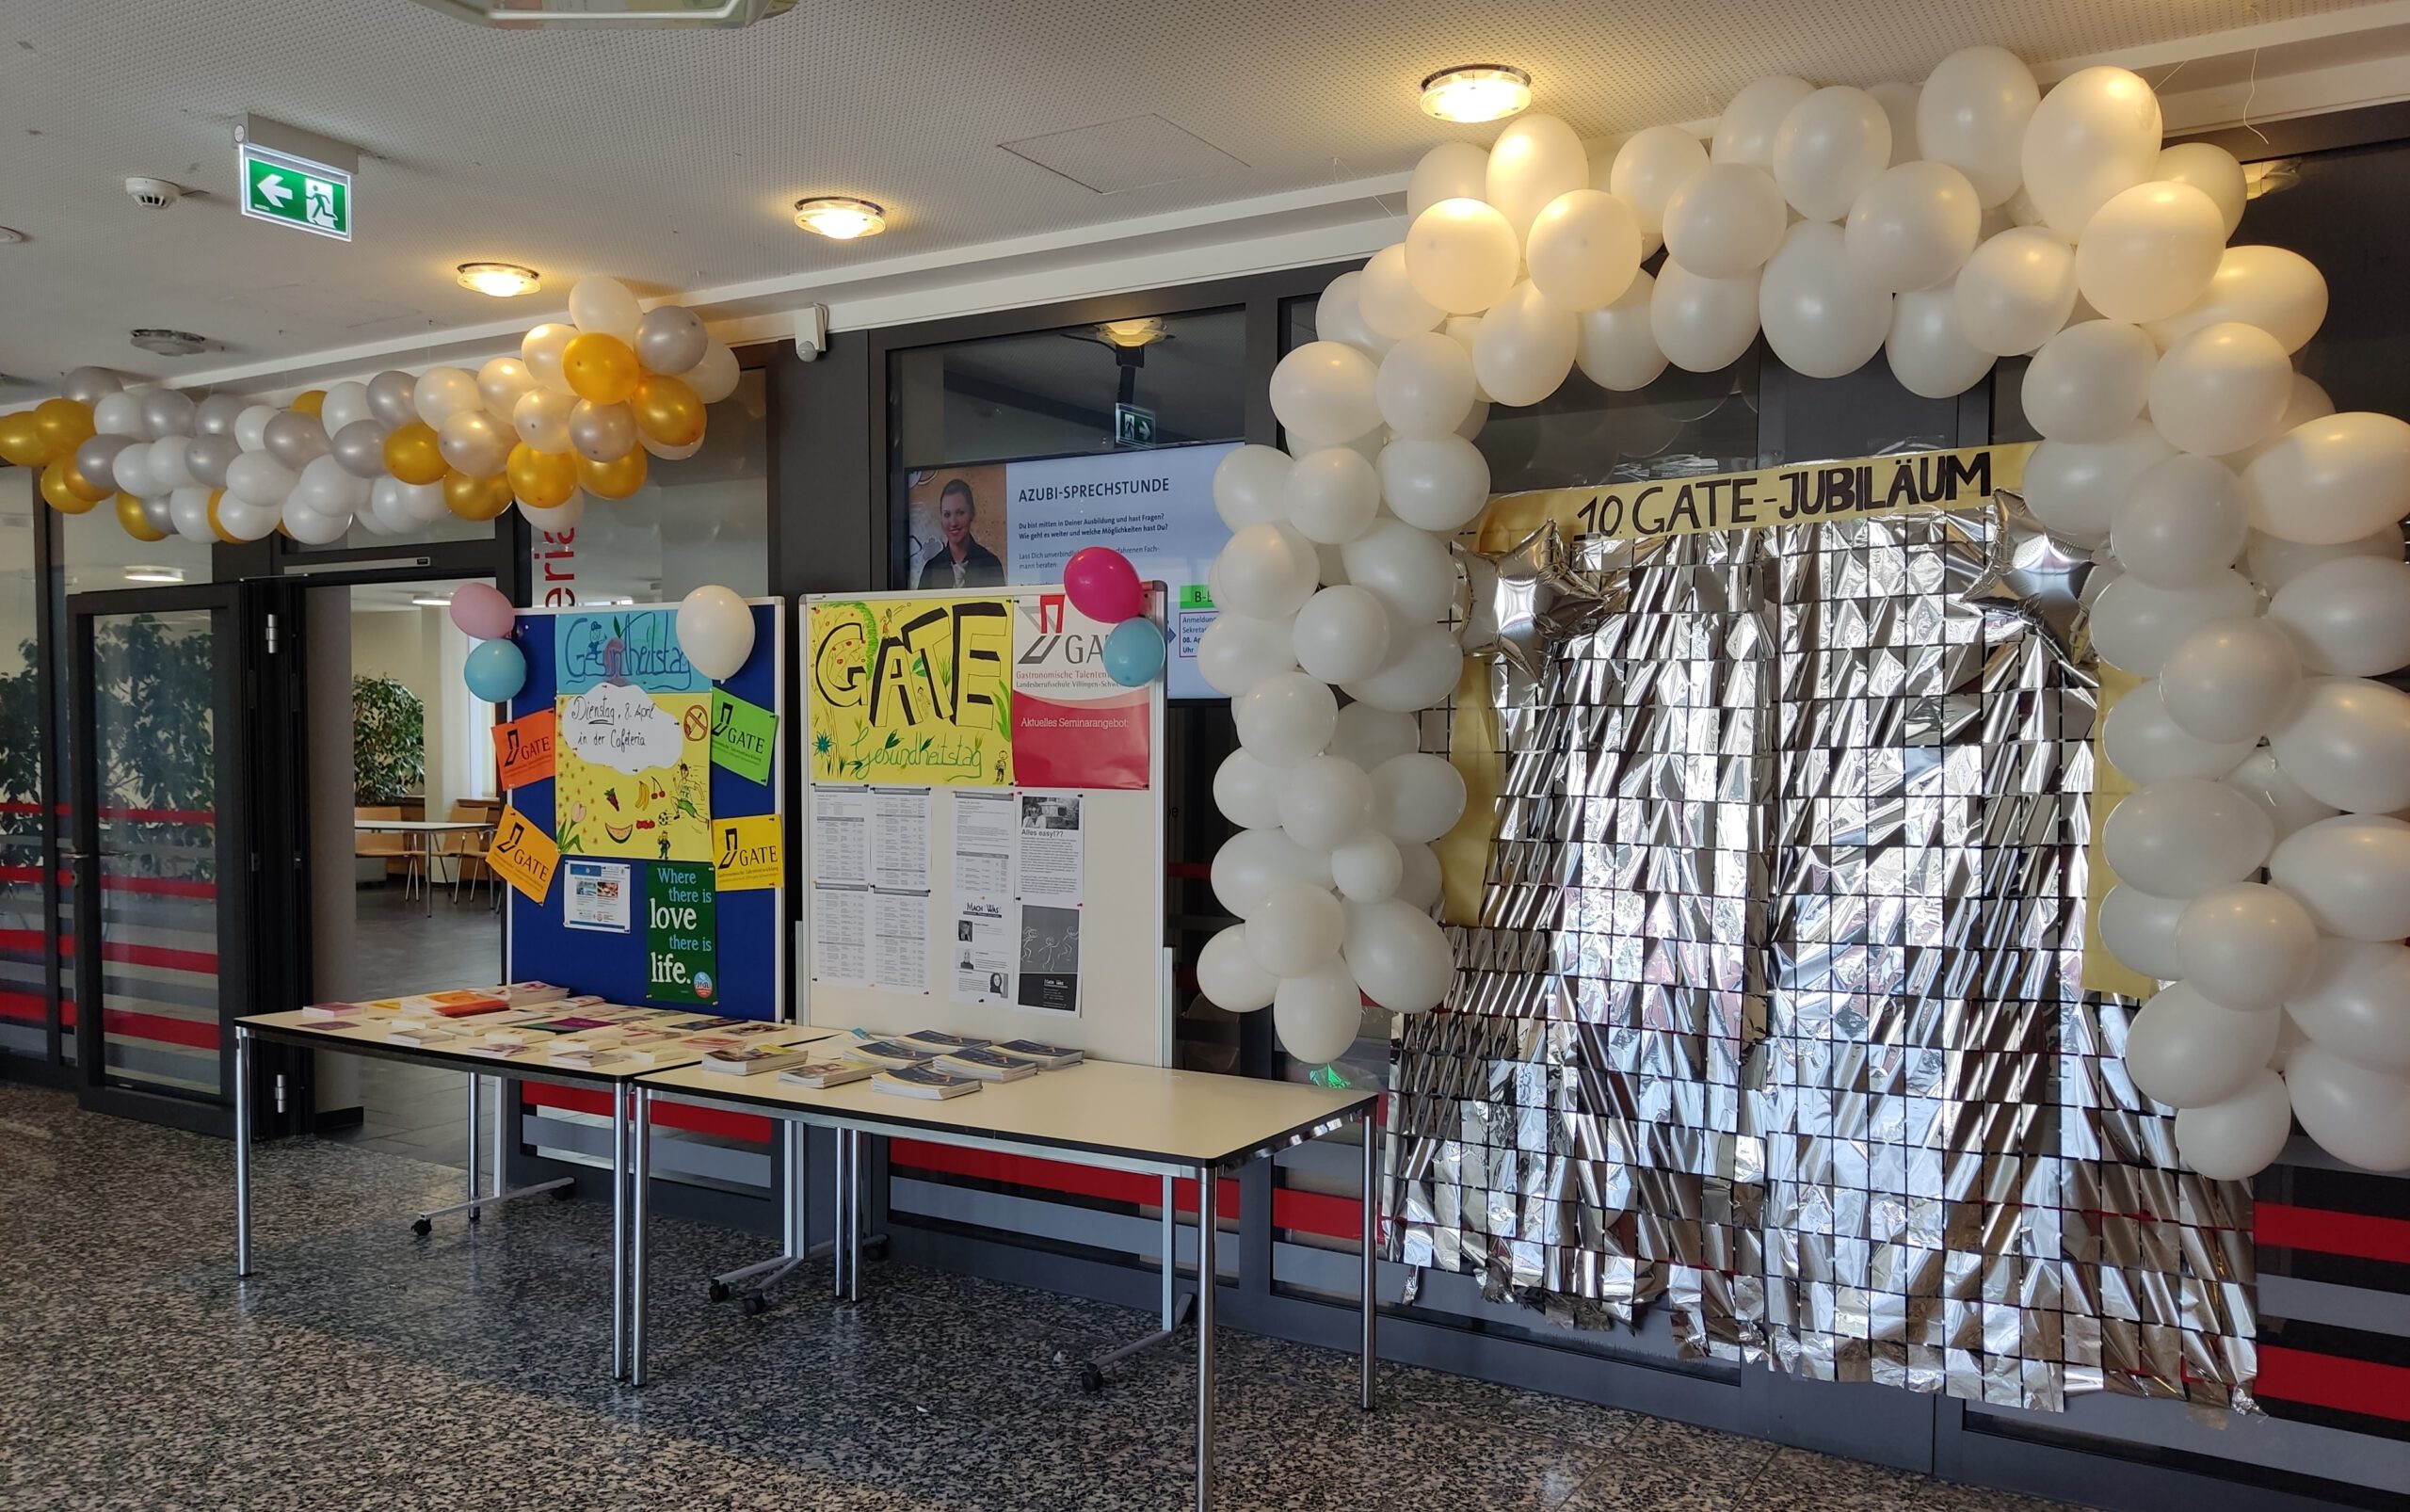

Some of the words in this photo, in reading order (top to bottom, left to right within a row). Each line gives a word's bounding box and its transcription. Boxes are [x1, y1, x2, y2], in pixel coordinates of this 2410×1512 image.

[1019, 478, 1169, 503] AZUBI-SPRECHSTUNDE
[1142, 513, 1165, 522] Fragen?
[1574, 494, 1623, 540] 10.
[1031, 531, 1042, 540] geht
[1051, 529, 1068, 538] weiter
[1102, 524, 1142, 535] Möglichkeiten
[1065, 635, 1109, 665] GA
[815, 602, 1008, 731] GATE
[1016, 670, 1073, 679] Gastronomische
[635, 702, 656, 719] April
[1020, 717, 1057, 728] Aktuelles
[1059, 717, 1129, 729] Seminarangebot:
[521, 737, 551, 761] GATE
[577, 732, 587, 746] in
[594, 733, 605, 746] der
[728, 728, 764, 754] GATE
[849, 727, 982, 780] Gesundheitstag
[514, 848, 549, 882] GATE
[739, 845, 778, 866] GATE
[657, 867, 697, 884] Where
[668, 887, 699, 903] there
[702, 889, 712, 904] is
[650, 897, 697, 930] love
[669, 934, 699, 951] there
[702, 937, 712, 952] is
[651, 951, 691, 985] life.
